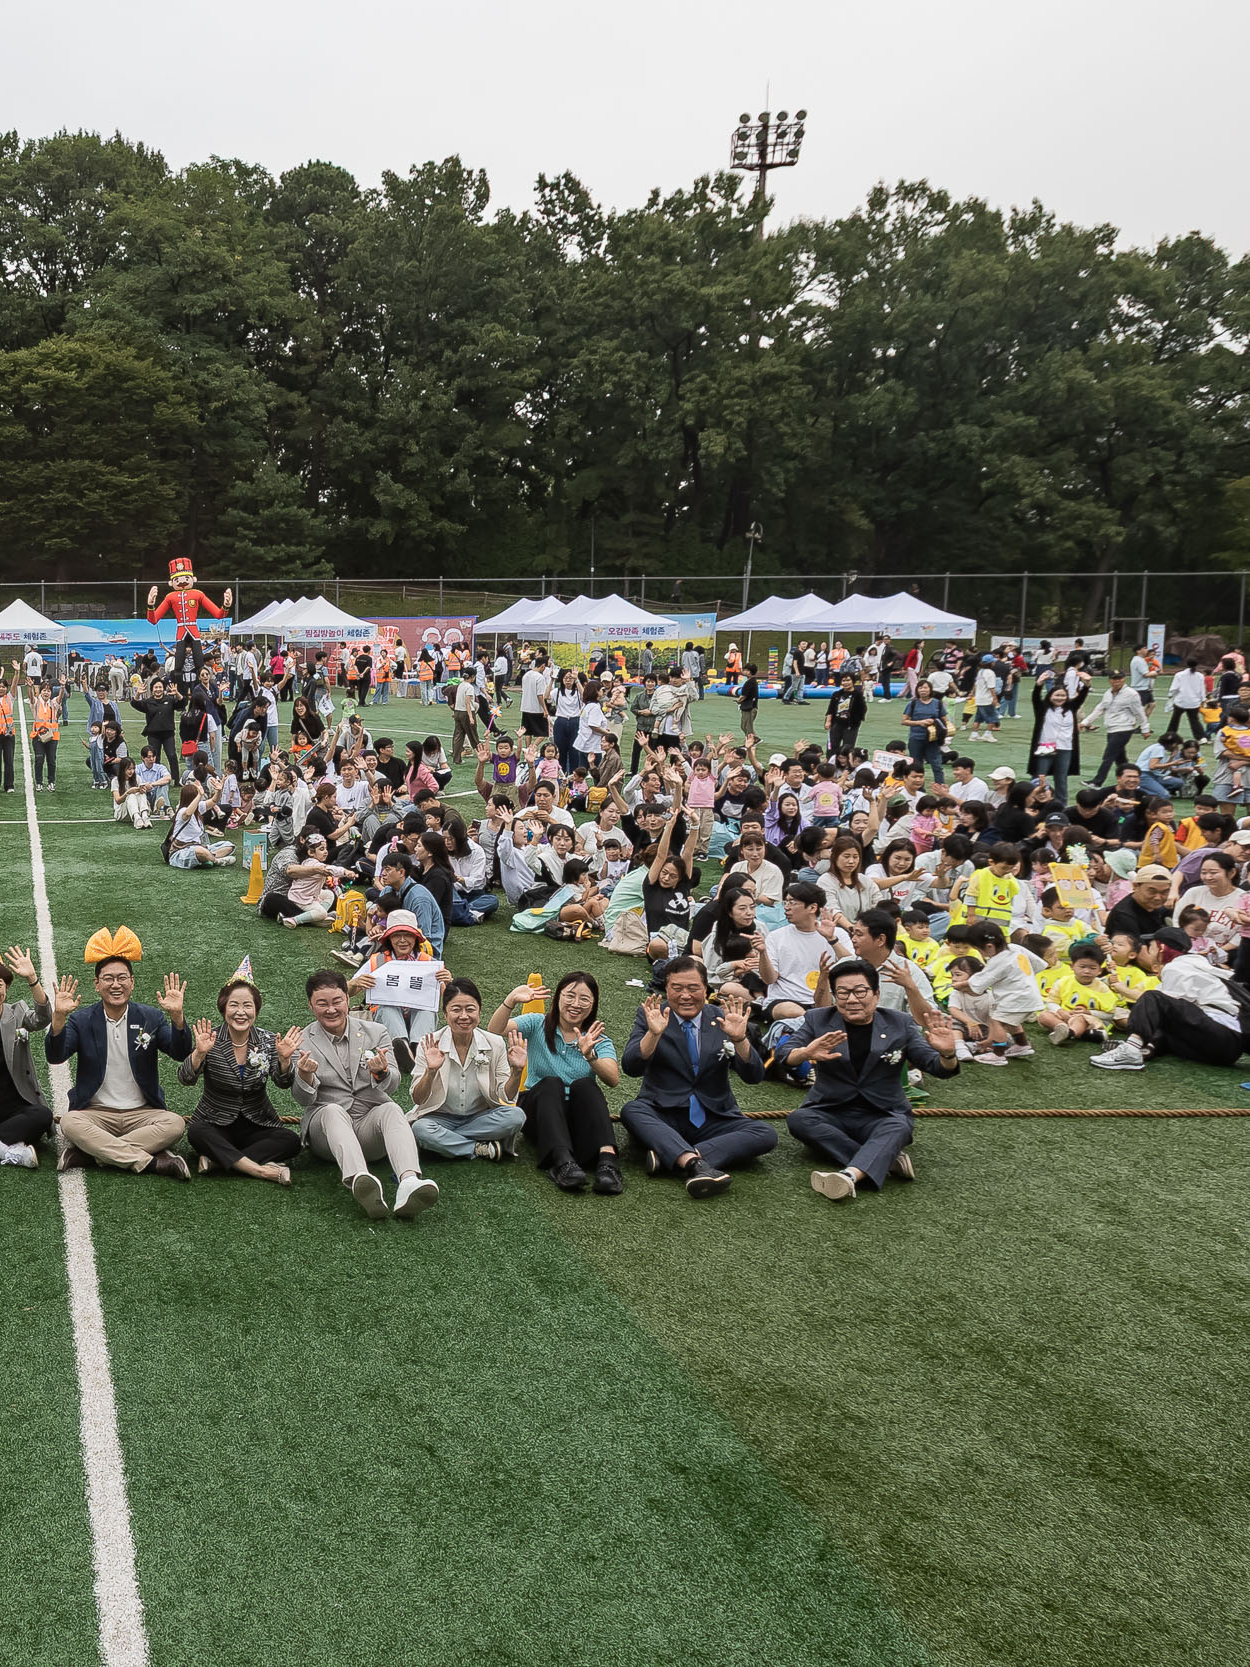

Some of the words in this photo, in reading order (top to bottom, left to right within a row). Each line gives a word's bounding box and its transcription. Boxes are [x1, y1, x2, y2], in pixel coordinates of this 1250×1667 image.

[305, 629, 344, 637] 찜질방놀이
[347, 629, 370, 637] 체험존
[608, 626, 639, 635] 오감만족
[642, 626, 665, 635] 체험존
[23, 632, 46, 640] 체험존
